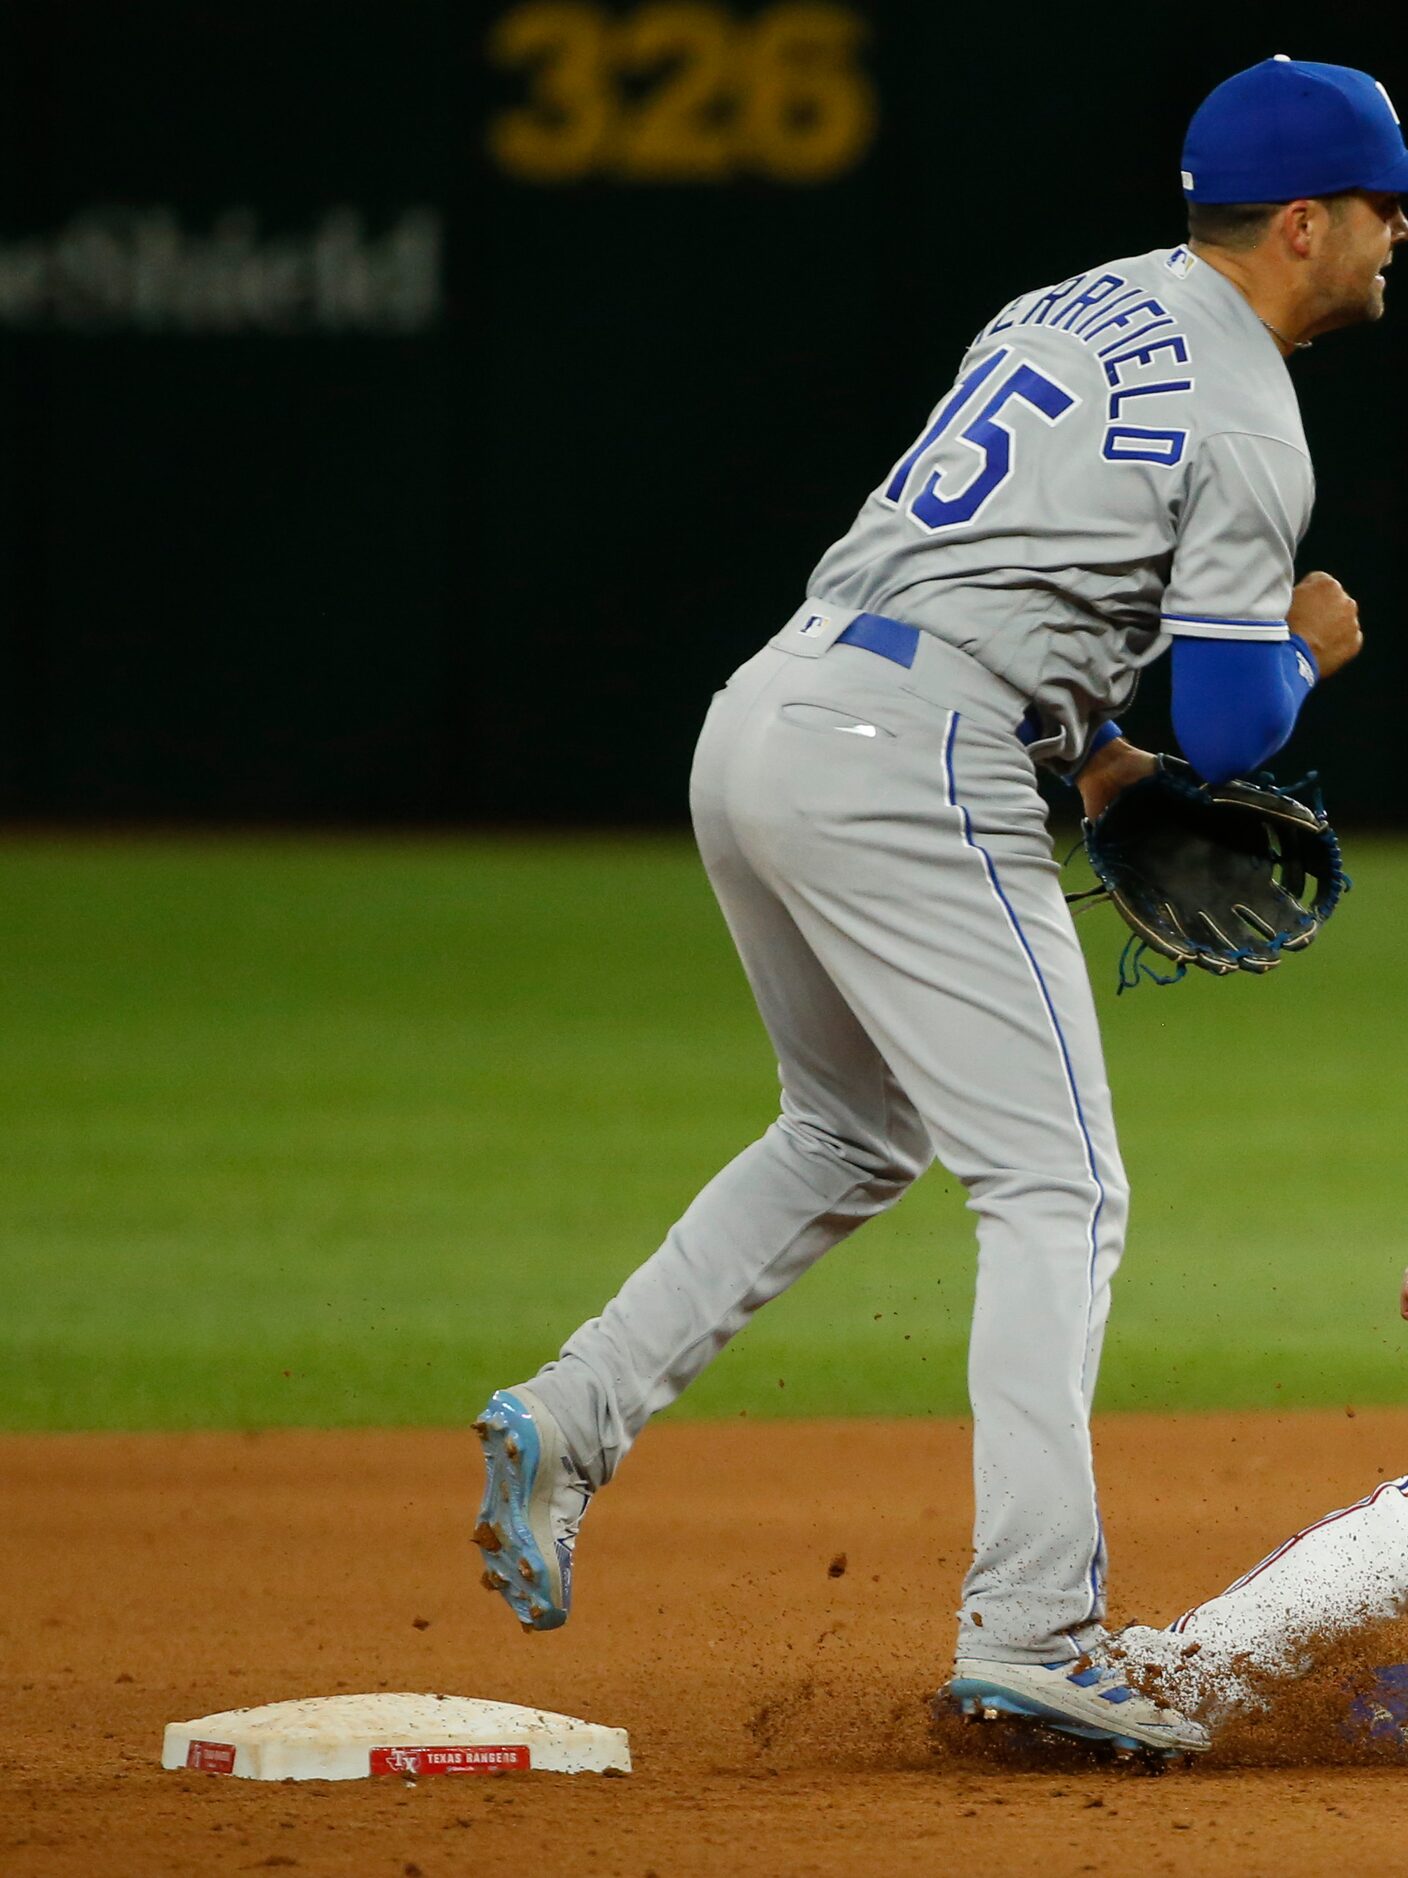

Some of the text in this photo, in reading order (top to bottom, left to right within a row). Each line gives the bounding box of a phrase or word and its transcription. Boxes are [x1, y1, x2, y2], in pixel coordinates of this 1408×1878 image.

[490, 4, 878, 184] 326
[882, 344, 1083, 535] 15
[972, 272, 1195, 470] ERRIFIELD
[427, 1753, 462, 1764] TEXAS
